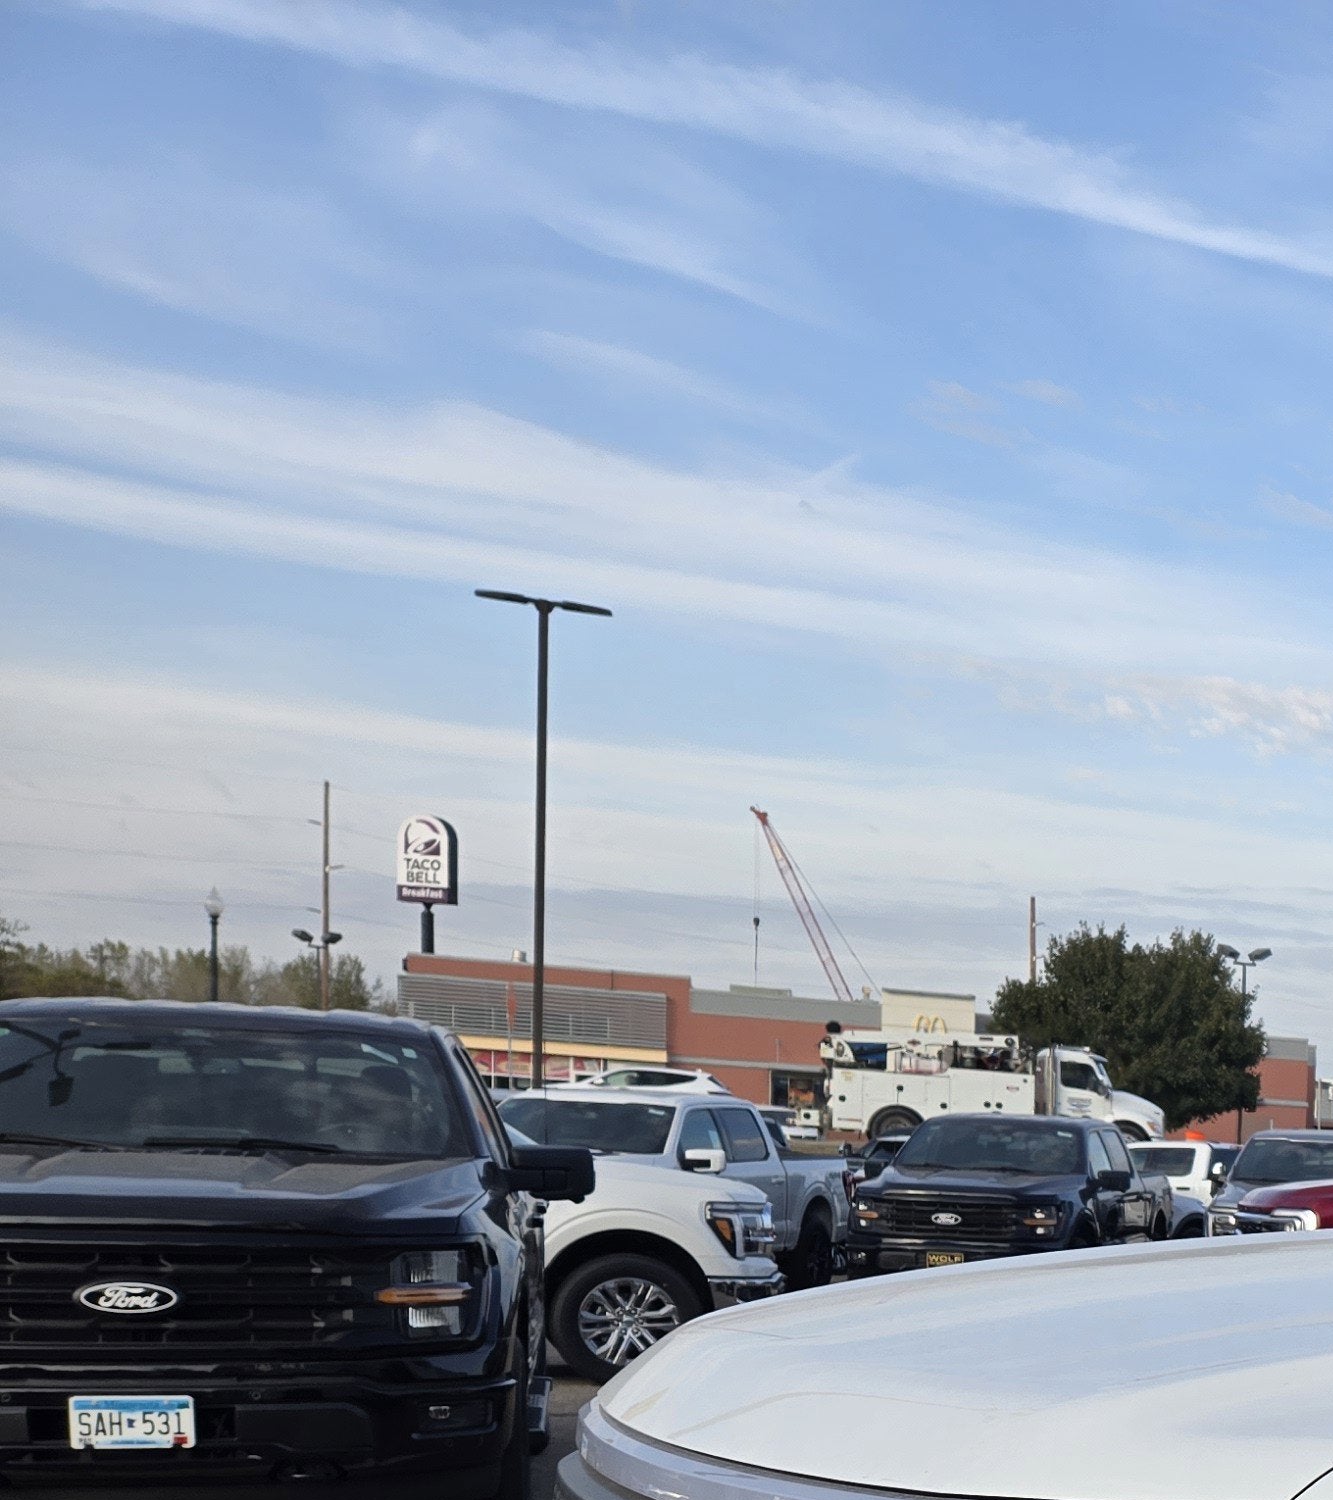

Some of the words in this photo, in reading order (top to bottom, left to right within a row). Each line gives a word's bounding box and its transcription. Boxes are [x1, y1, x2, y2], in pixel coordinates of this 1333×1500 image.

[403, 858, 441, 871] TACO
[406, 870, 441, 884] BELL
[98, 1287, 159, 1308] Ford
[78, 1411, 123, 1436] SAH
[142, 1410, 186, 1435] 531
